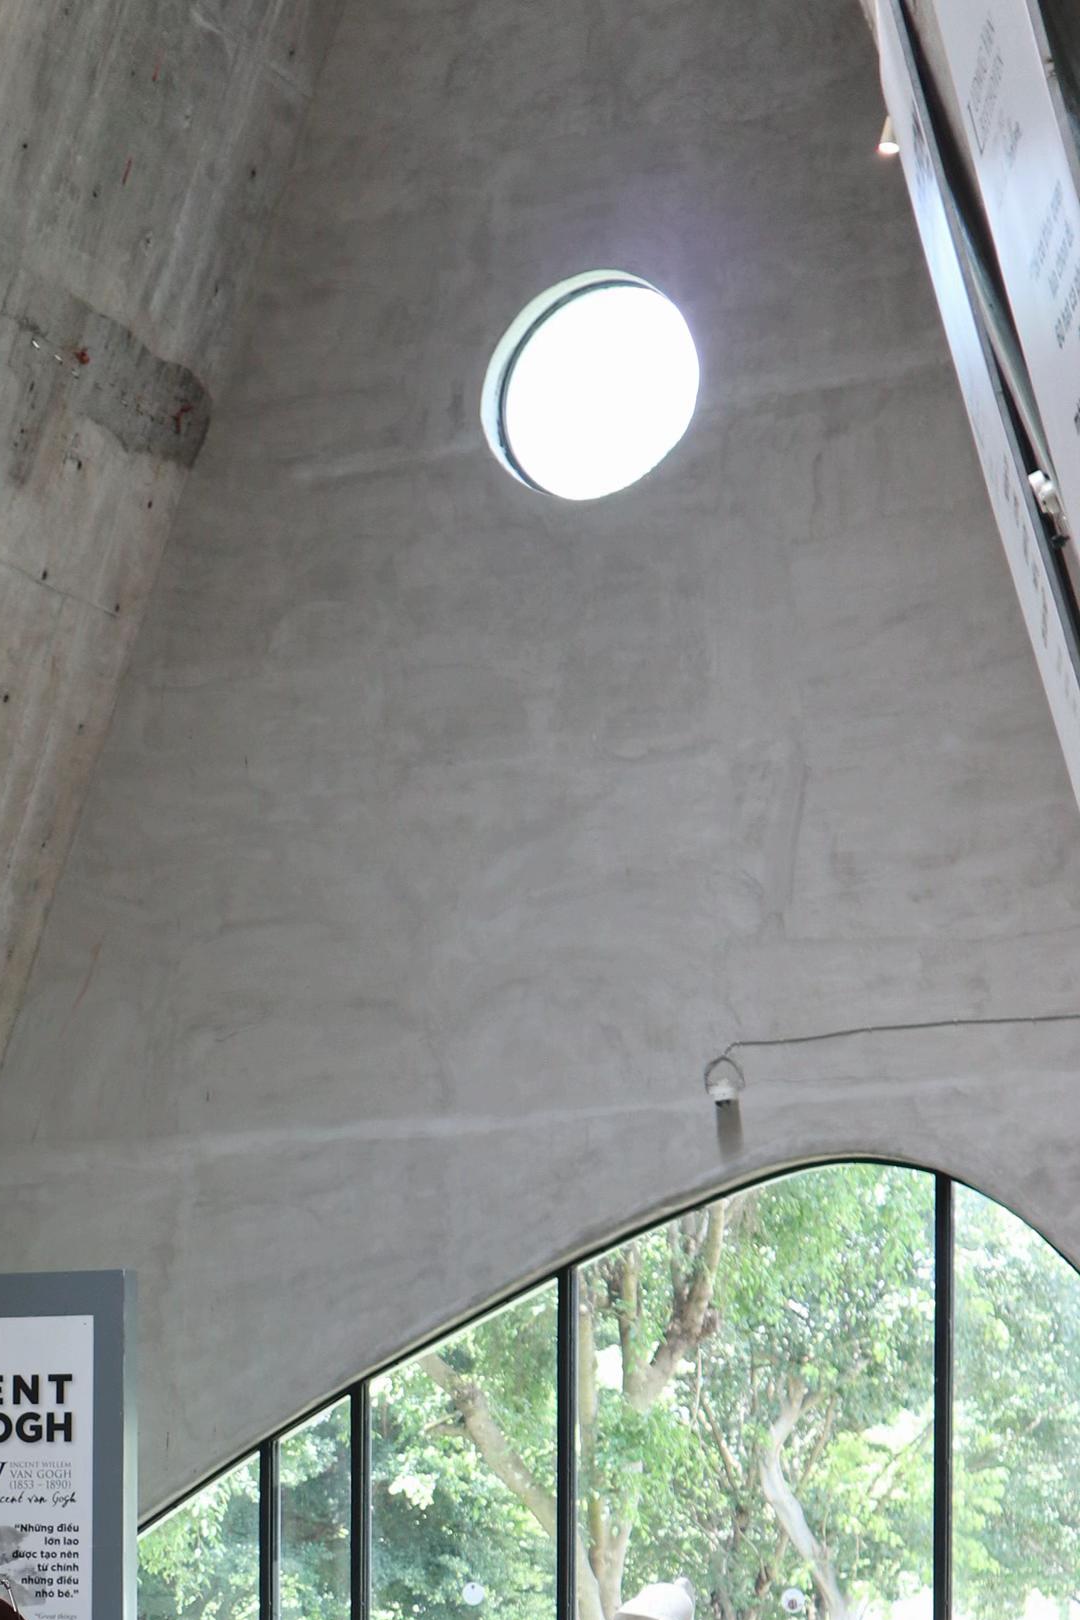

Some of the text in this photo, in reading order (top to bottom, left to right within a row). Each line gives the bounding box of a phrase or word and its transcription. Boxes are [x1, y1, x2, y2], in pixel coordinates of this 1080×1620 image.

[10, 1469, 72, 1479] VAN GOGH
[63, 1536, 79, 1545] lao
